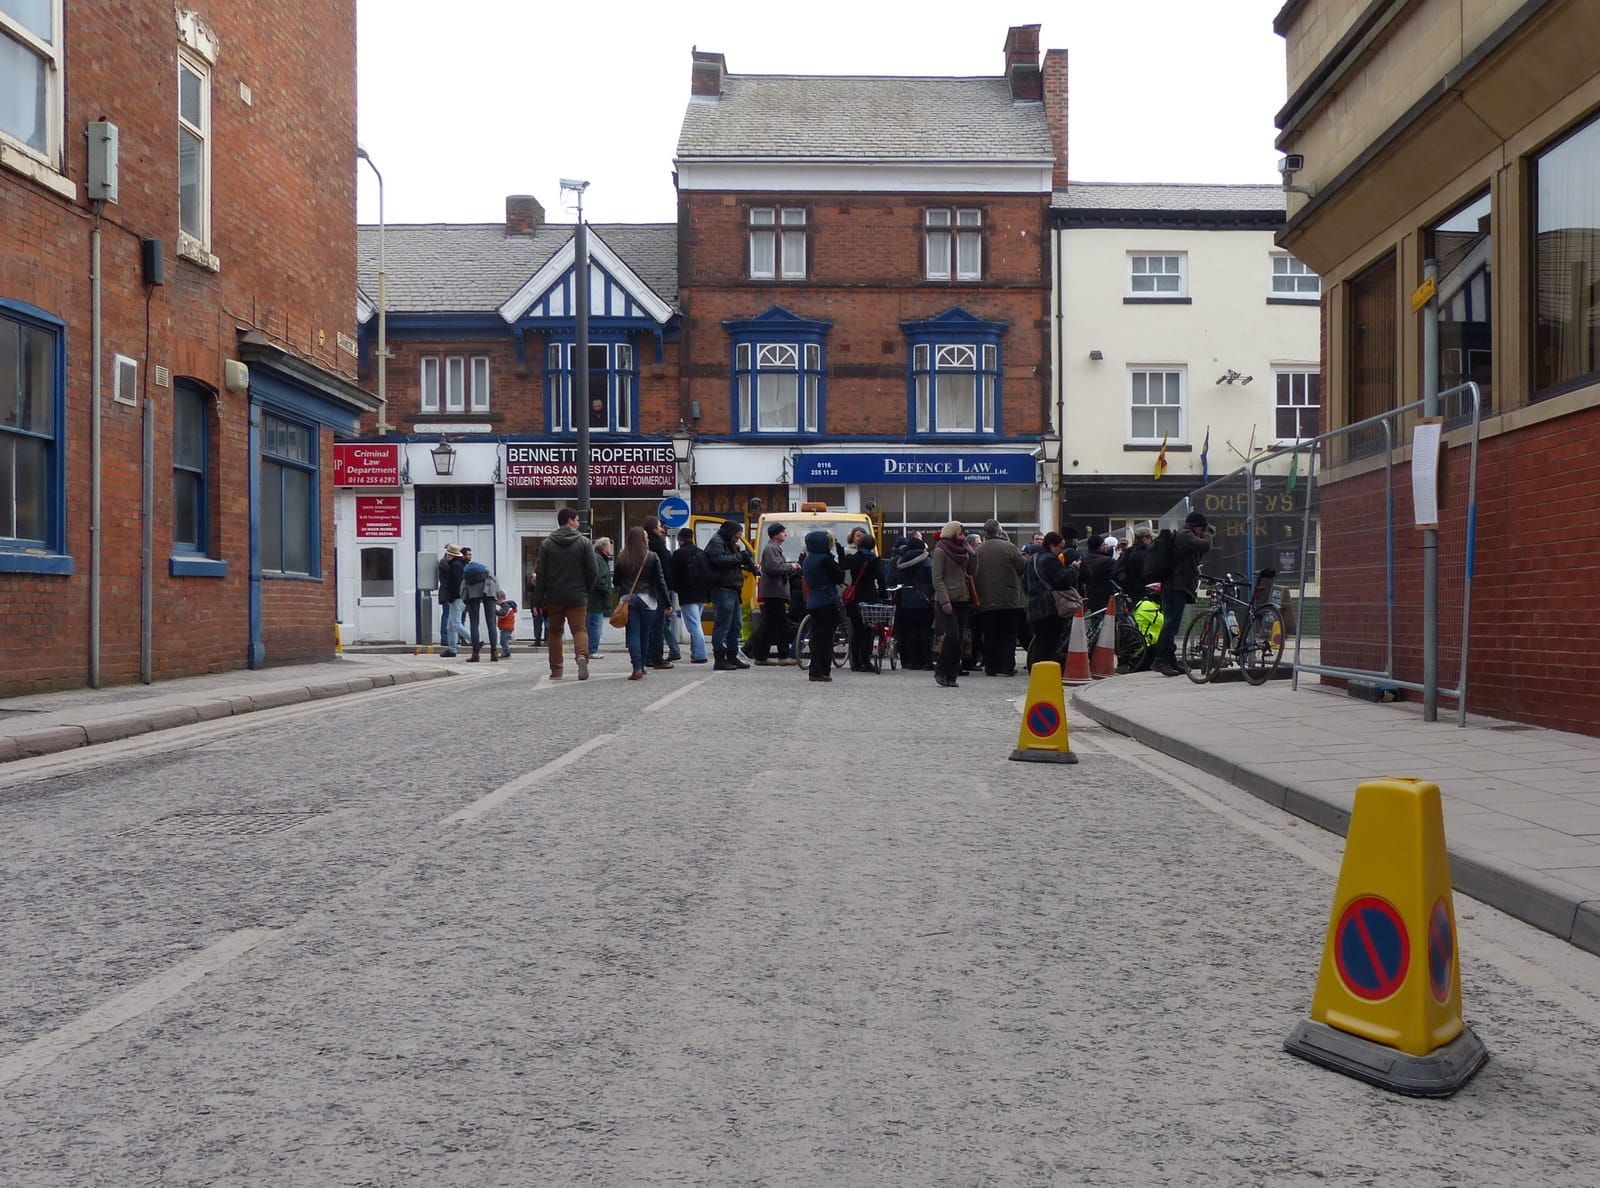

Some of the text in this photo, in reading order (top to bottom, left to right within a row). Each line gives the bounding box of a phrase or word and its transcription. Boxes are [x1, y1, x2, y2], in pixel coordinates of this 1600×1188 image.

[354, 450, 389, 458] Criminal
[509, 448, 675, 462] BENNETT ROPERTIES
[363, 458, 380, 466] Law
[347, 466, 397, 476] Department
[507, 465, 673, 475] LETTINGS AN ESTATE AGENTS
[543, 476, 593, 486] PROFESSIOS
[609, 476, 618, 486] TO
